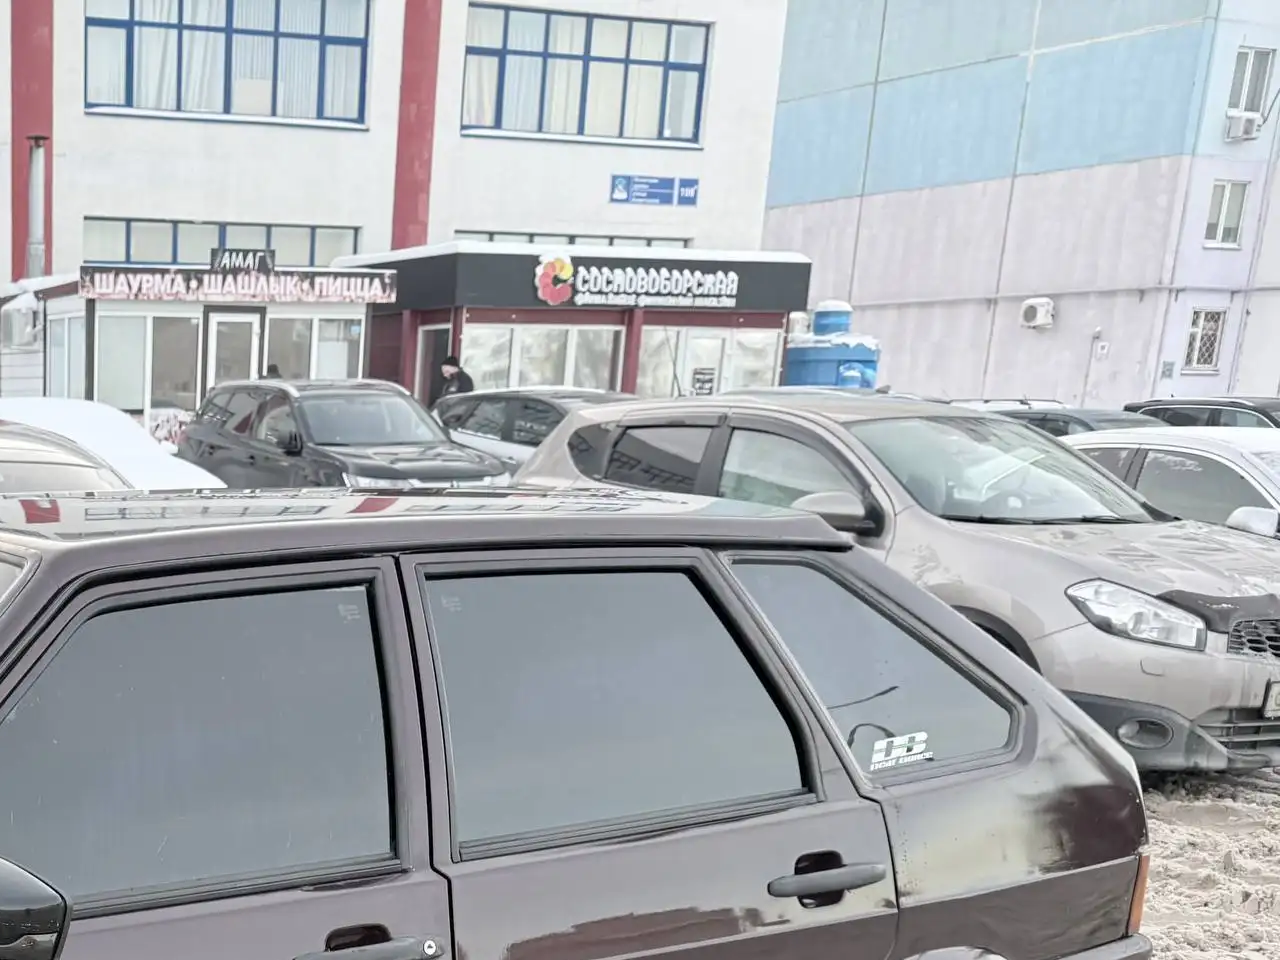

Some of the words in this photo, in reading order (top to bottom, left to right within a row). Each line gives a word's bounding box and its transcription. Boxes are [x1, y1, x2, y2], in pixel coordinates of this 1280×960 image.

[221, 251, 264, 270] АМАГ
[94, 271, 187, 295] ШАУРМА
[202, 273, 299, 297] ШАШЛЫК
[314, 276, 382, 298] ПИЦЦА
